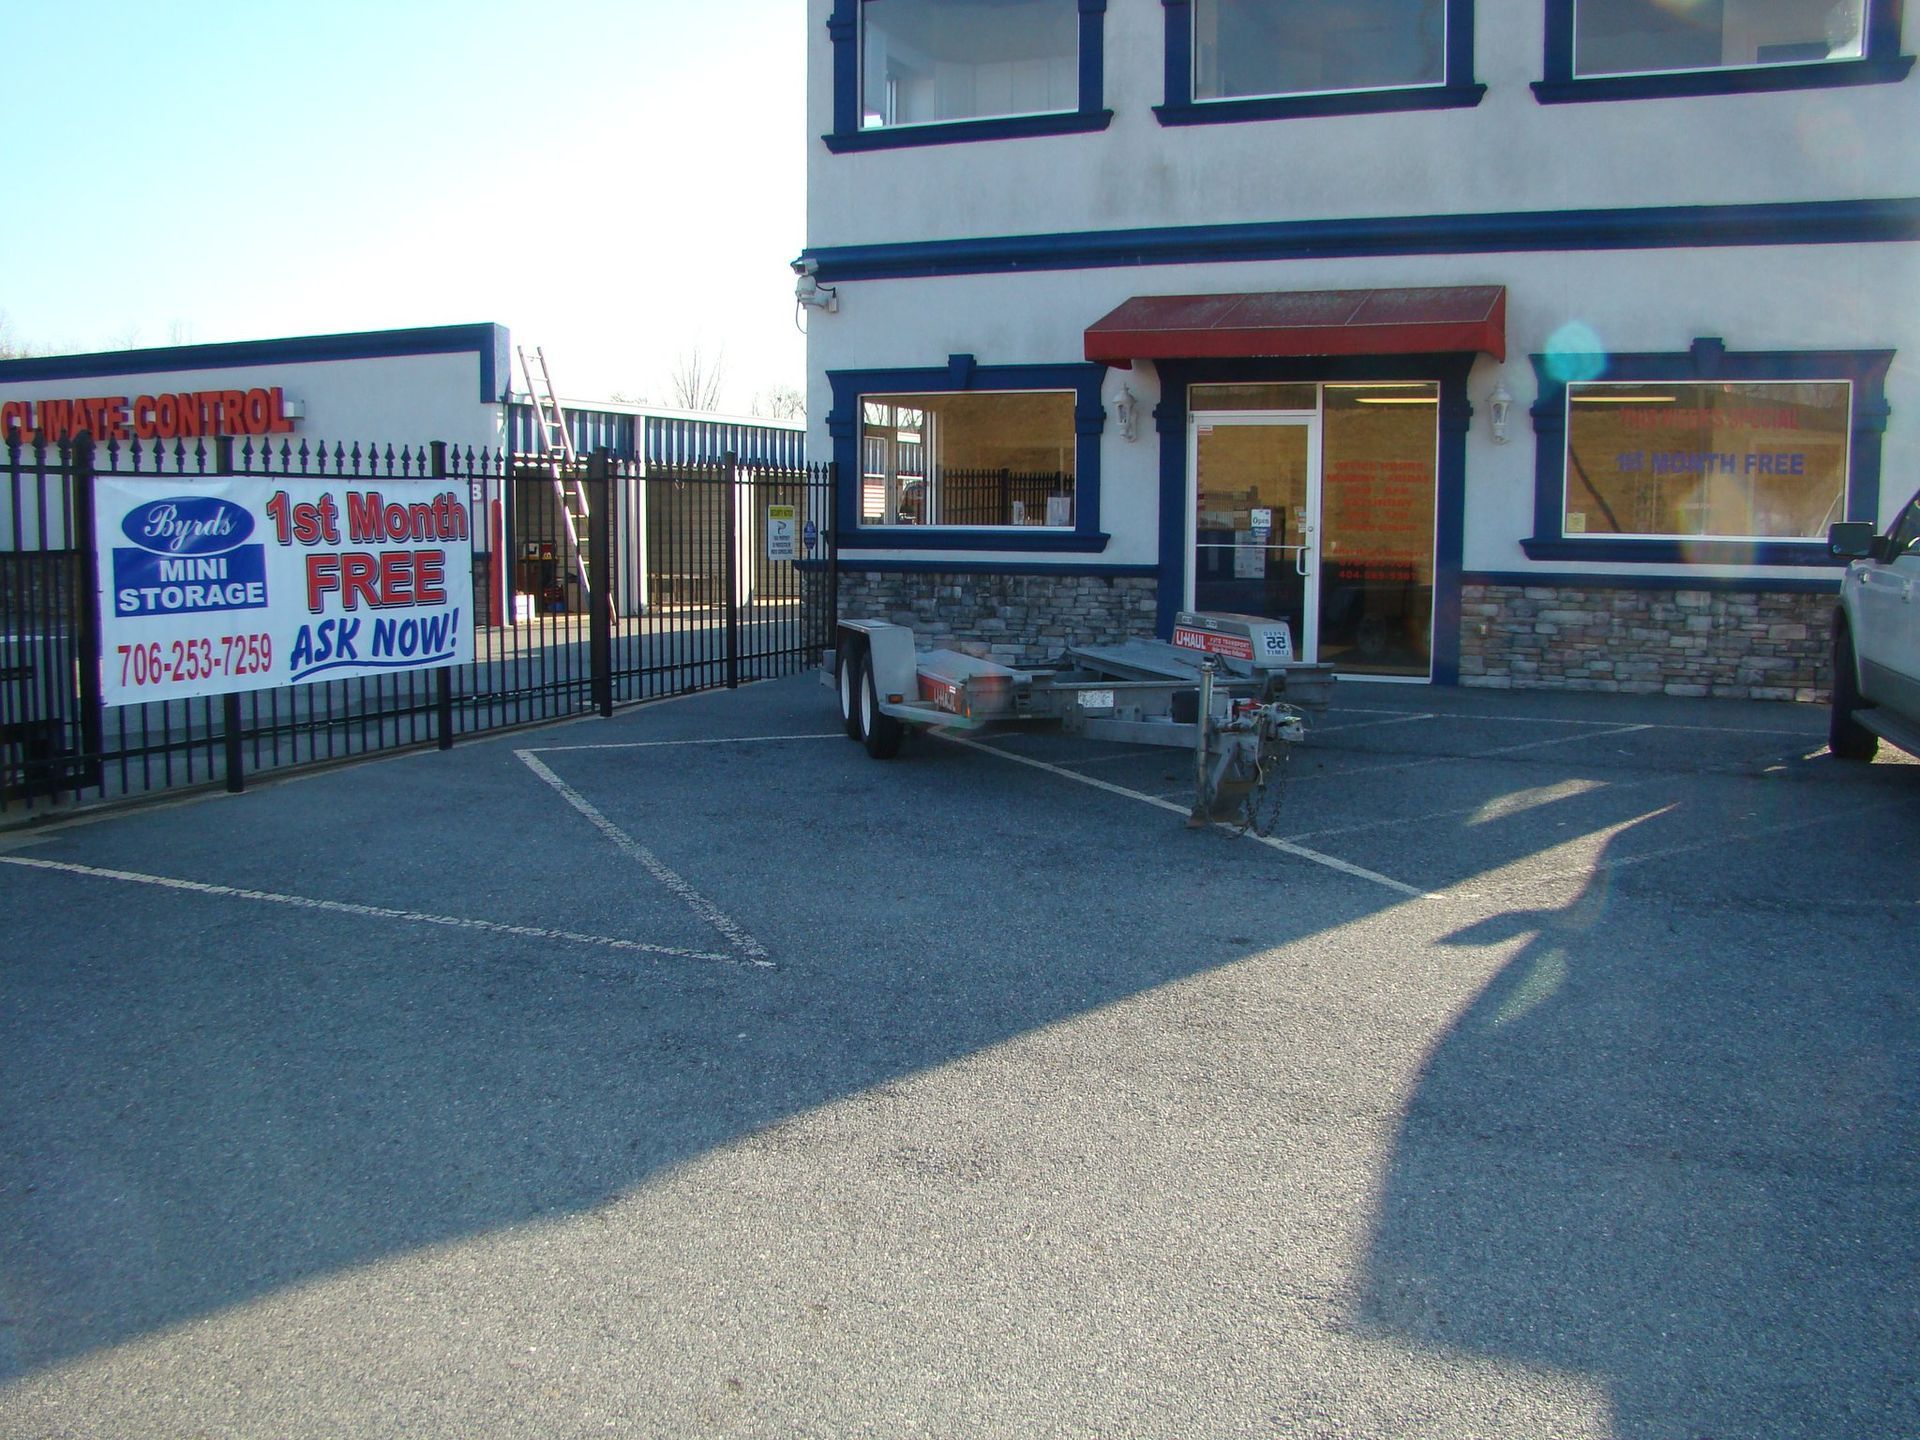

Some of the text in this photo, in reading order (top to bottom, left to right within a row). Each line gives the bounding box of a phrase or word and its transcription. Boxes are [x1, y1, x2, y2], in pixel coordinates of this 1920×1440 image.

[1, 387, 294, 443] CLIMATE CONTROL
[1652, 453, 1736, 475] MONTH
[1745, 453, 1806, 475] FREE
[144, 504, 238, 551] Byrds
[266, 490, 470, 546] 1st Month
[159, 558, 228, 582] MINI
[305, 549, 448, 614] FREE
[119, 582, 265, 612] STORAGE
[118, 633, 272, 687] 706-253-7259
[290, 607, 460, 671] ASK NOW!
[1176, 631, 1207, 650] U-HAUL
